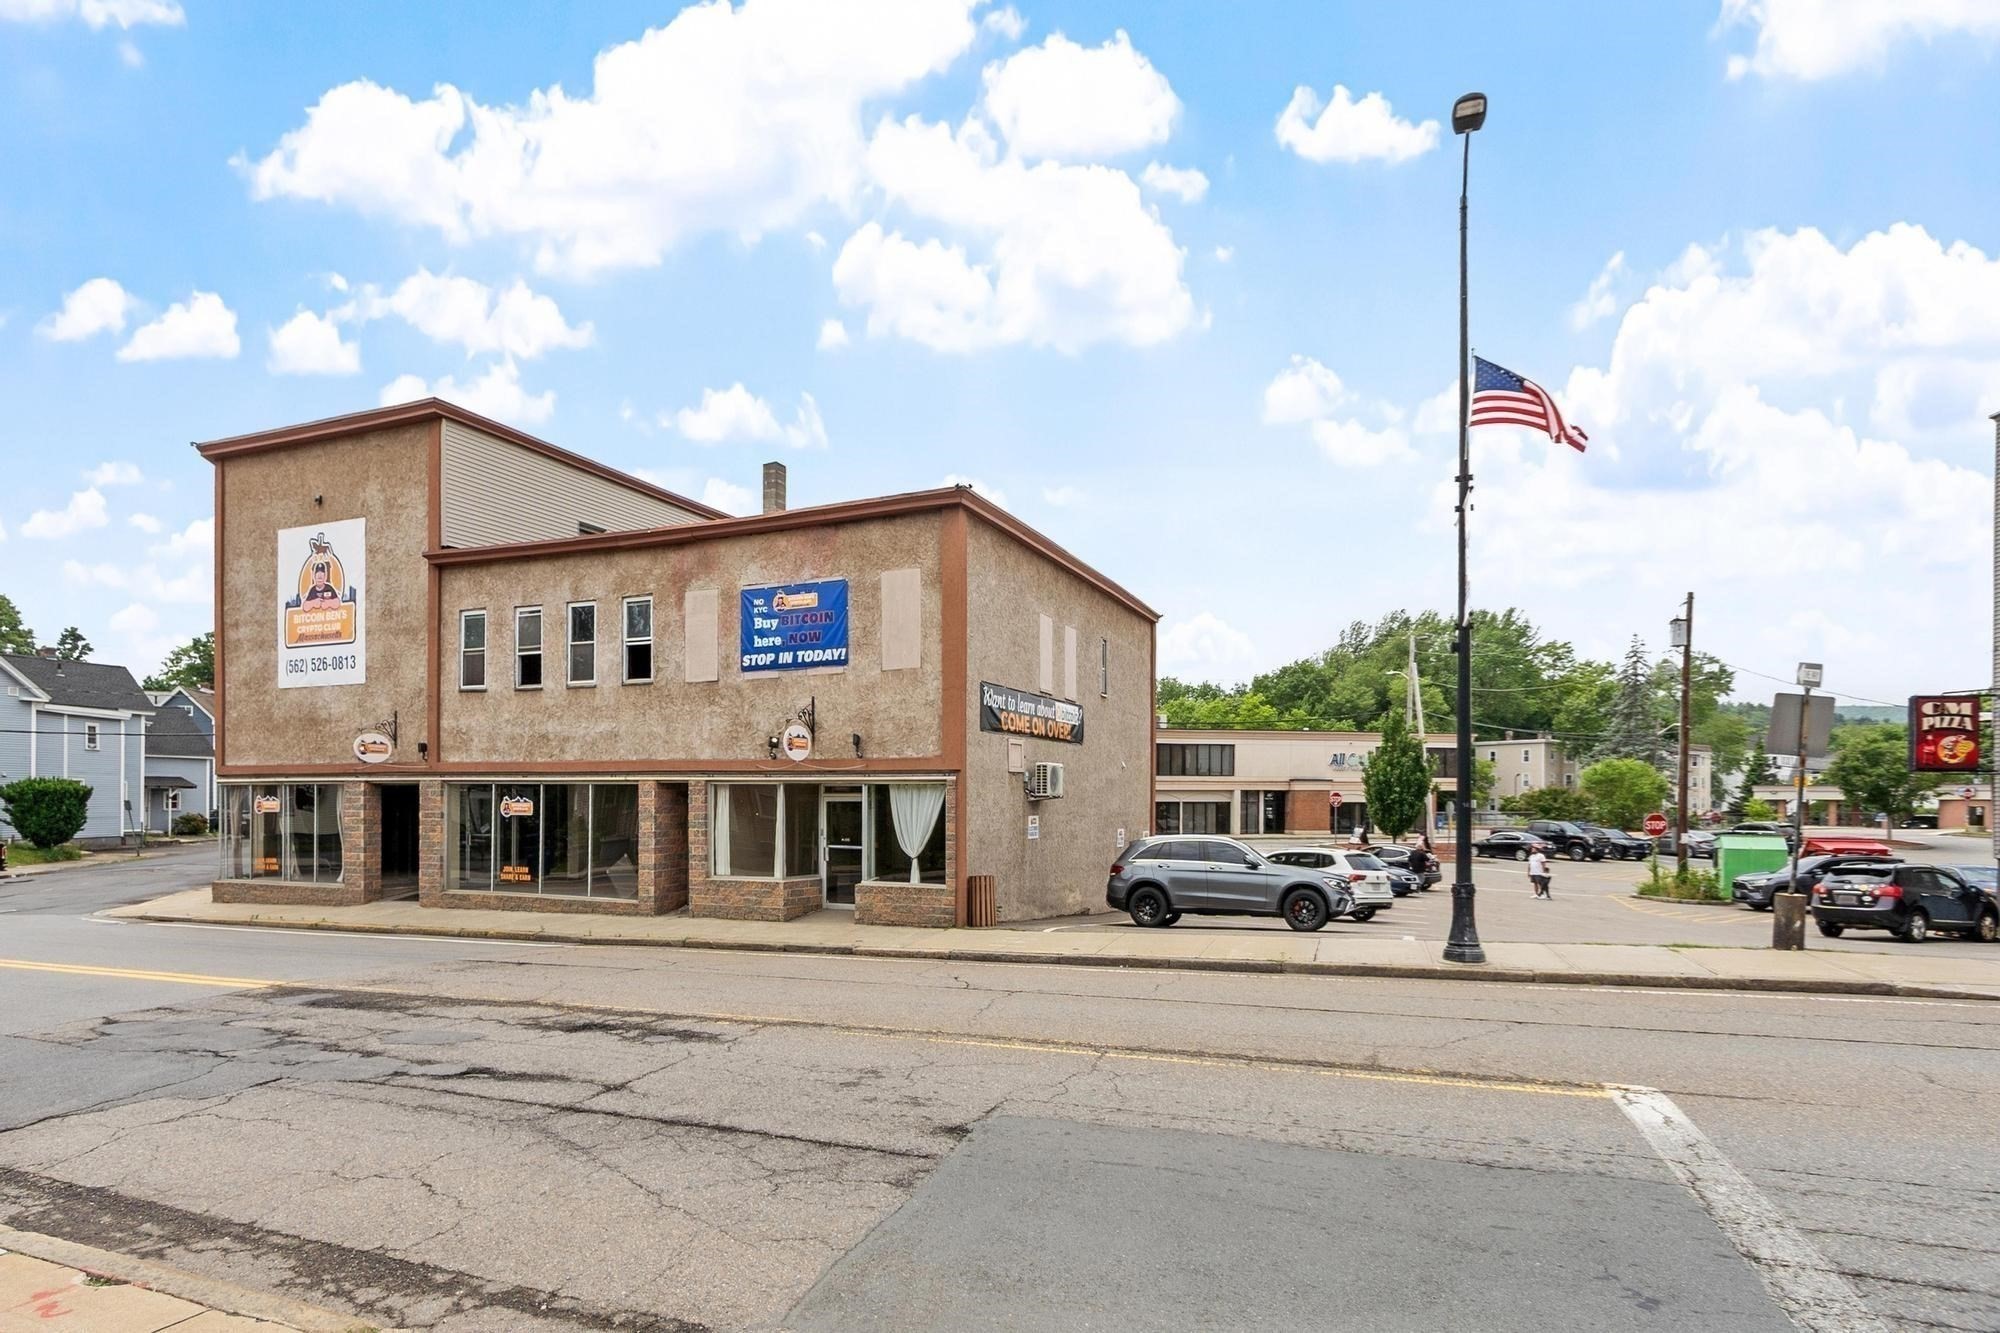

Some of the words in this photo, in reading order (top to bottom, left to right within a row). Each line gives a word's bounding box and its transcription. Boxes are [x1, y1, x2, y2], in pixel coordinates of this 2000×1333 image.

[293, 611, 325, 624] BITCOIN
[326, 609, 347, 621] BEN'S
[753, 617, 779, 630] Buy
[781, 610, 834, 626] BITCOIN
[297, 623, 322, 634] CRYPTO
[323, 622, 341, 631] CLUB
[788, 631, 822, 645] NOW
[742, 653, 775, 667] STOP
[778, 651, 793, 664] IN
[796, 648, 847, 663] TODAY!
[285, 657, 308, 677] (562)
[311, 655, 356, 672] 526-0813
[983, 685, 1006, 709] Want
[1008, 695, 1016, 711] to
[1017, 693, 1035, 715] learn
[1037, 699, 1055, 719] about
[1001, 711, 1030, 733] COME
[1032, 717, 1046, 736] ON
[1047, 720, 1072, 740] OVER!
[1921, 716, 1974, 731] PIZZA
[1328, 752, 1345, 766] All
[1645, 820, 1666, 830] STOP
